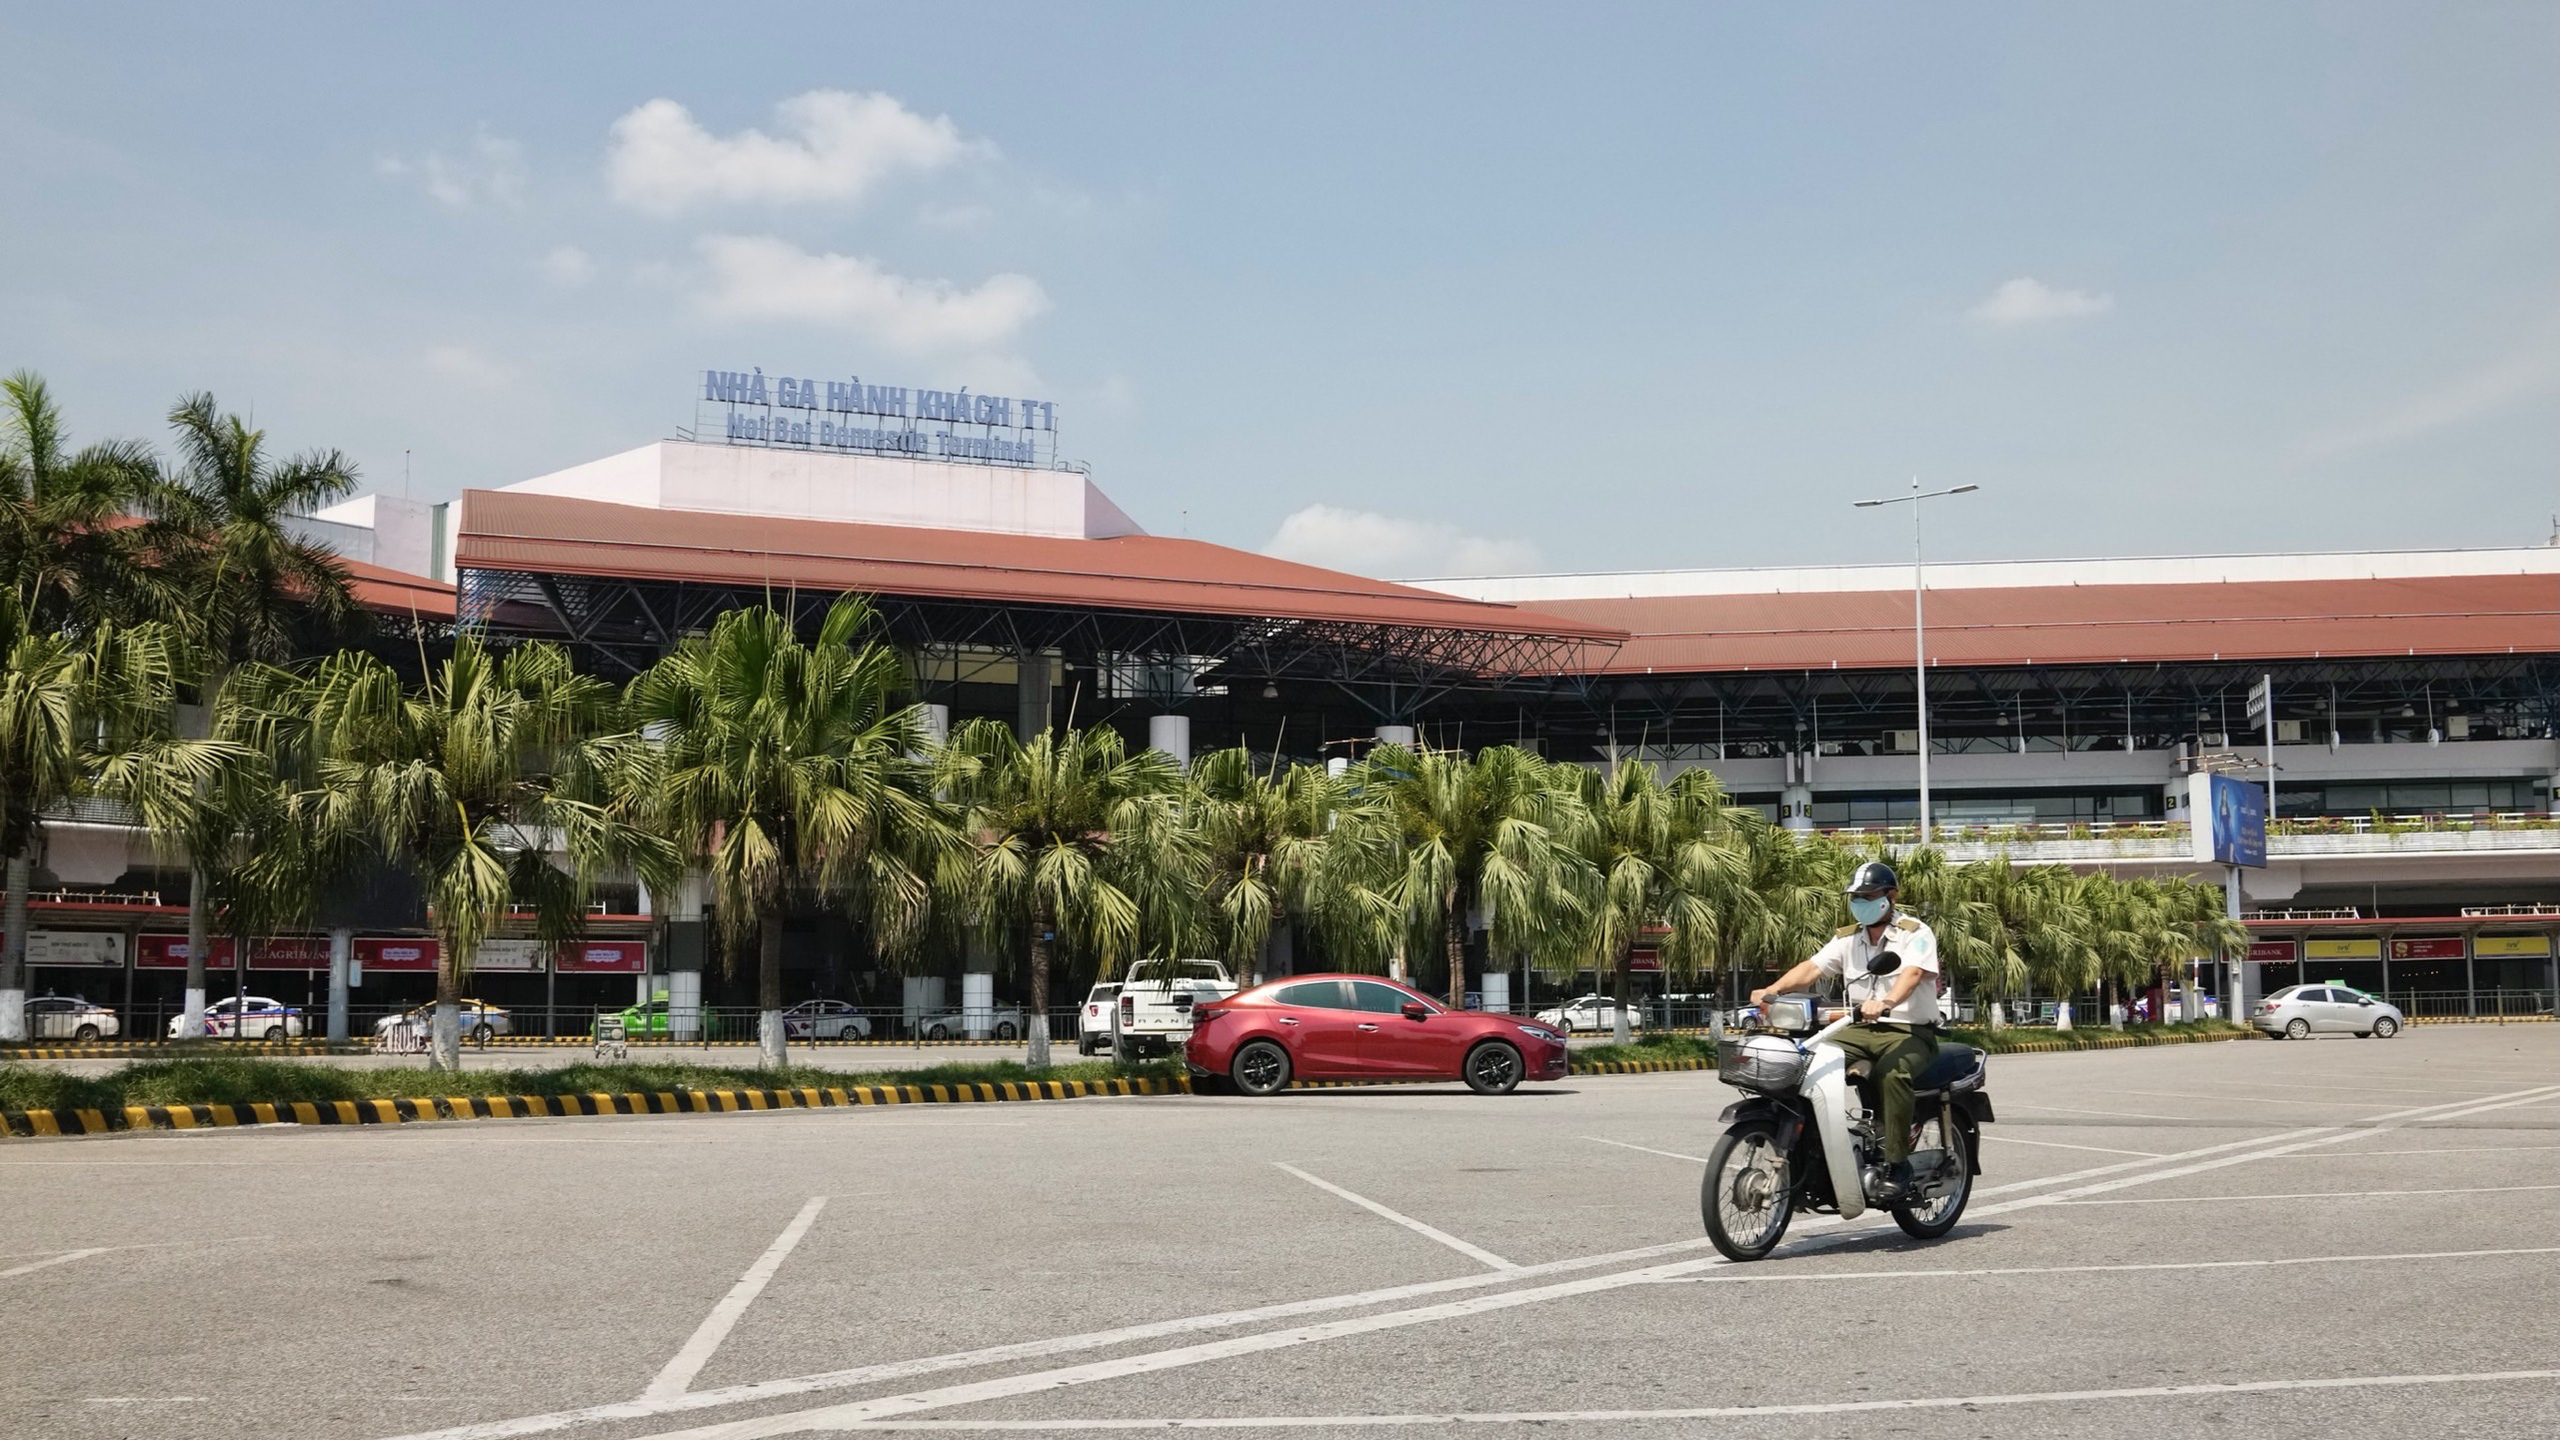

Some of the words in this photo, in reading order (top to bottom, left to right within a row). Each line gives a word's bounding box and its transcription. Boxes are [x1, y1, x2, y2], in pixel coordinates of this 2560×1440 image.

[705, 366, 768, 406] NHÀ
[778, 376, 817, 410] GA
[827, 375, 907, 417] HÀNH
[916, 386, 1010, 427] KHÁCH
[1021, 400, 1053, 430] T1
[727, 412, 766, 441] Noi
[774, 416, 811, 445] Bai
[820, 420, 928, 453] Domestic
[936, 430, 1035, 463] Terminal
[2168, 798, 2174, 808] 2
[1784, 807, 1789, 816] 3
[1805, 806, 1810, 817] 3
